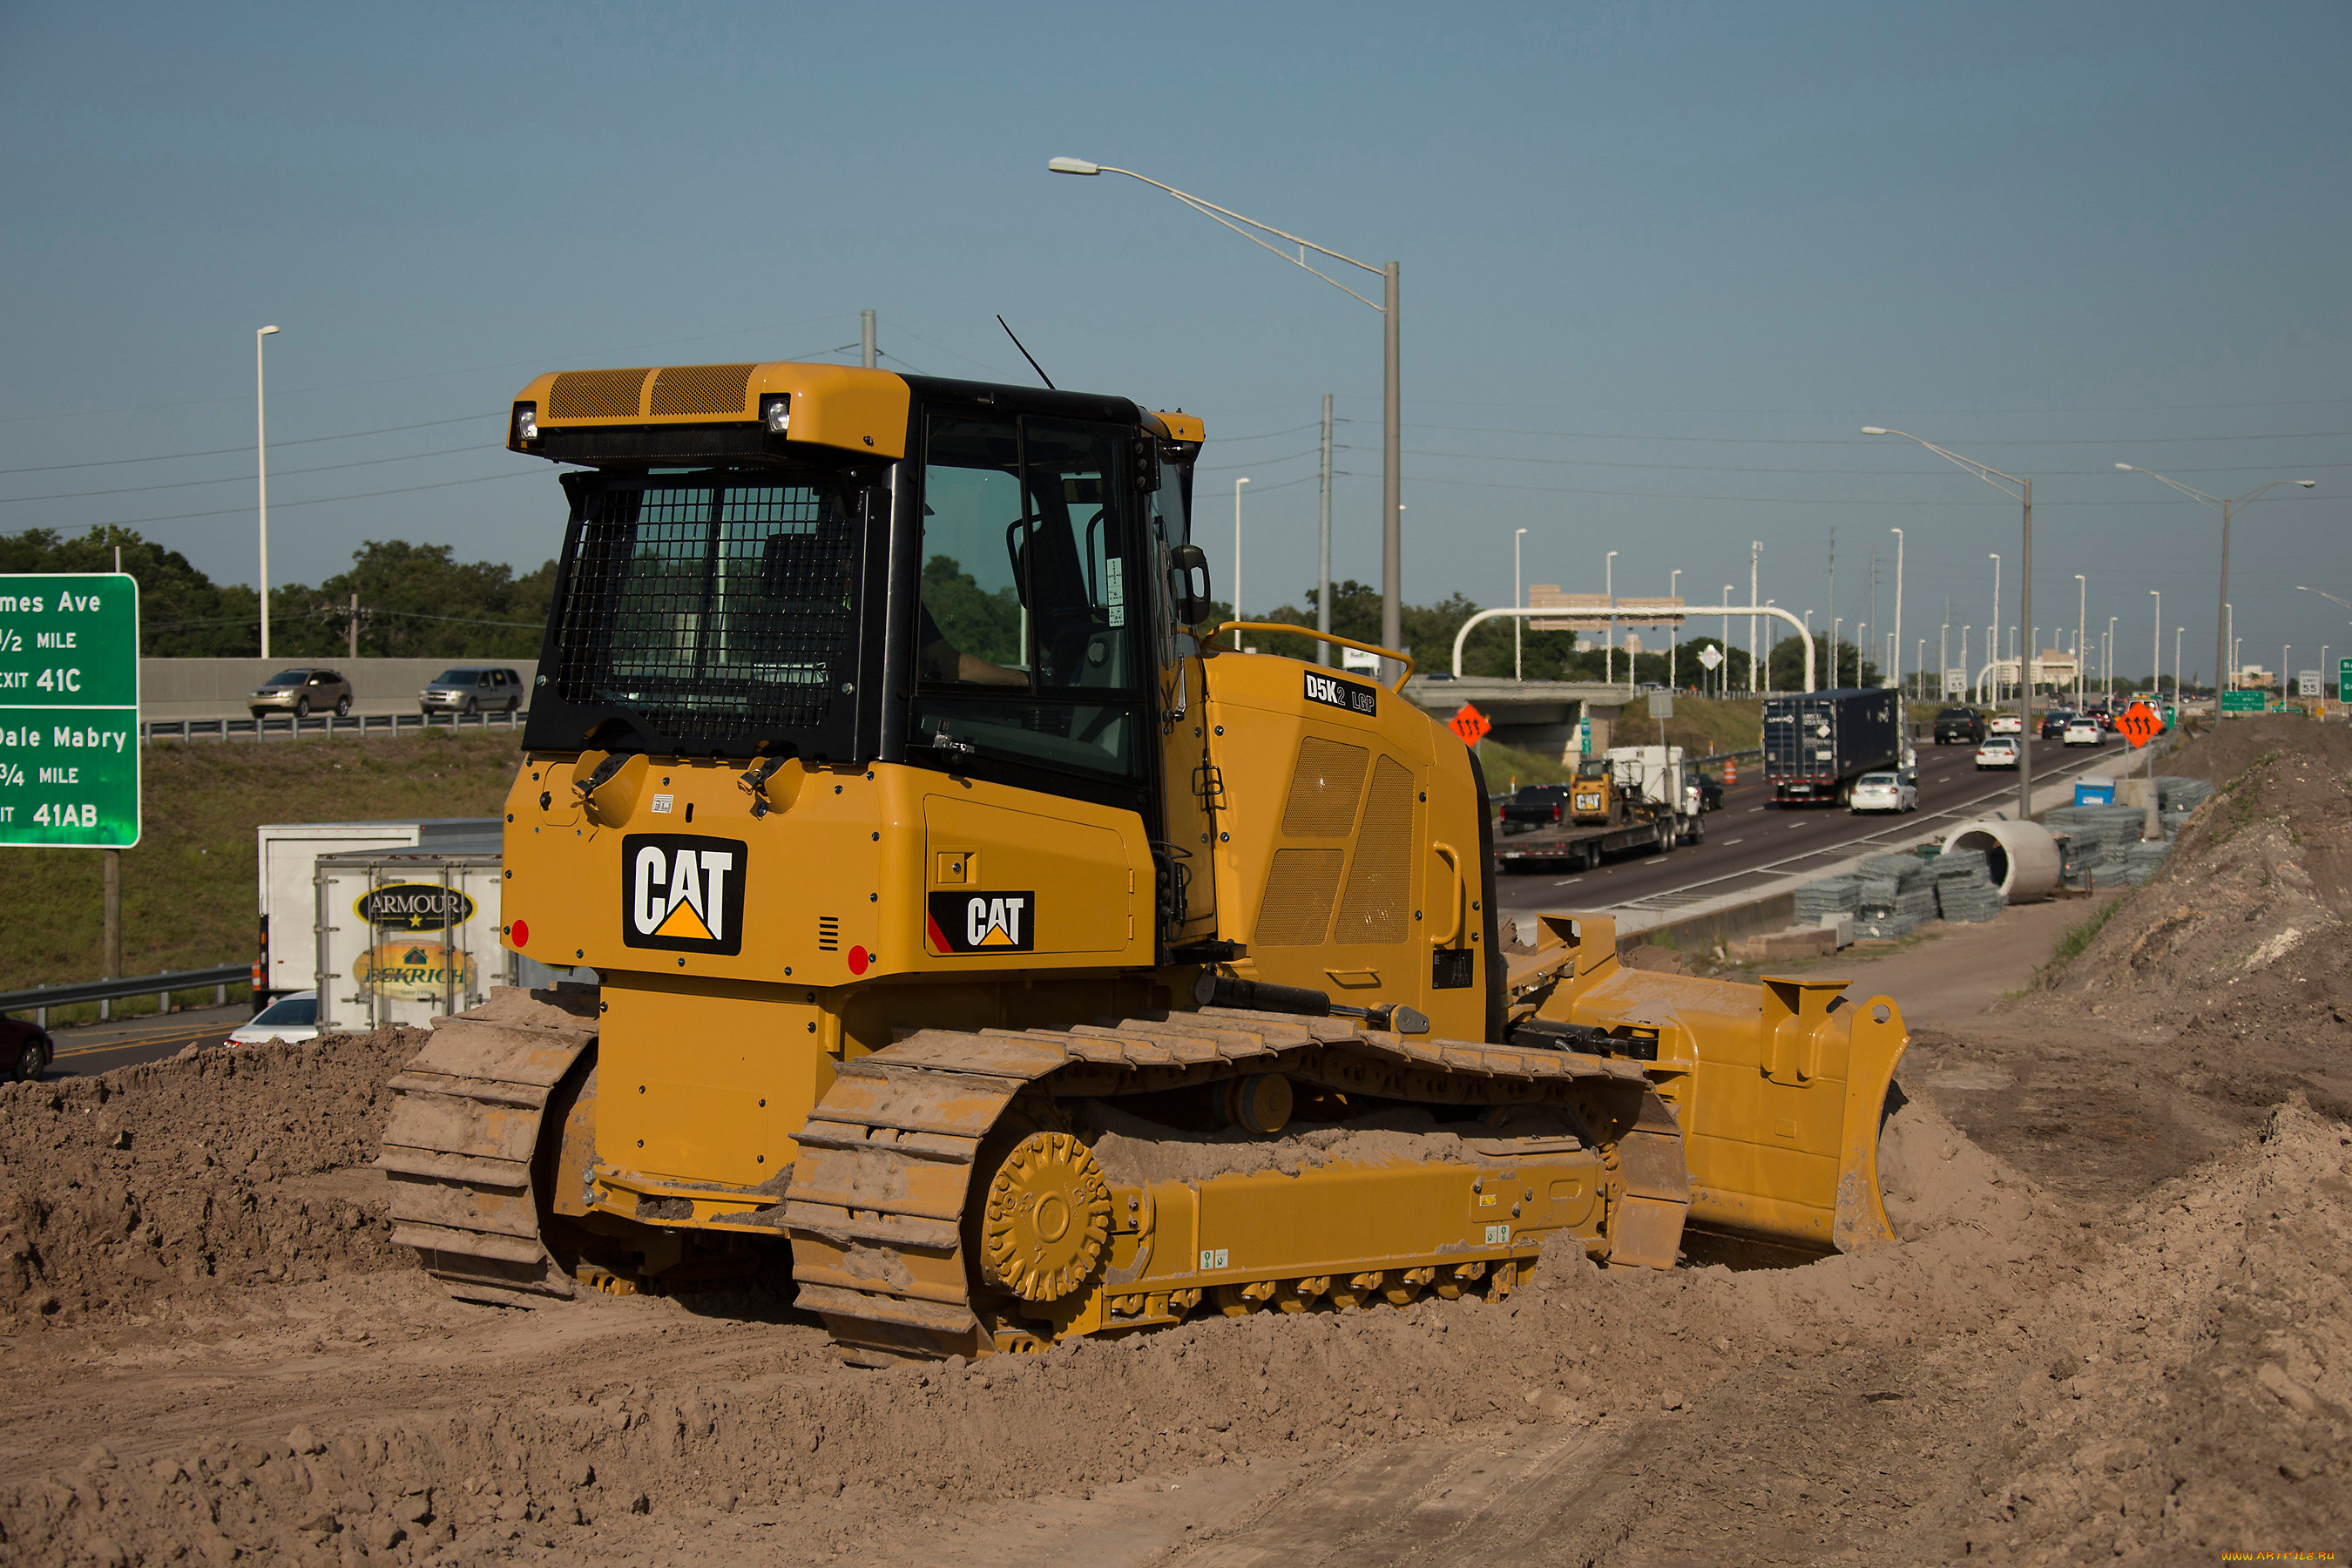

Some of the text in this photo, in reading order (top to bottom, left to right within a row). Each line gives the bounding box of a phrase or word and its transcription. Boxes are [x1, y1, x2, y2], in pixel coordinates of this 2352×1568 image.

[57, 591, 101, 612] Ave
[37, 632, 77, 649] MILE
[0, 668, 81, 693] XIT 41C
[2302, 684, 2317, 693] 55
[1351, 691, 1375, 713] LGP
[53, 726, 126, 754] Mabry
[39, 767, 79, 784] MILE
[1577, 794, 1600, 810] CAT
[33, 803, 98, 828] 41AB
[634, 846, 733, 941] CAT
[370, 895, 460, 914] ARMOUR
[967, 897, 1024, 946] CAT
